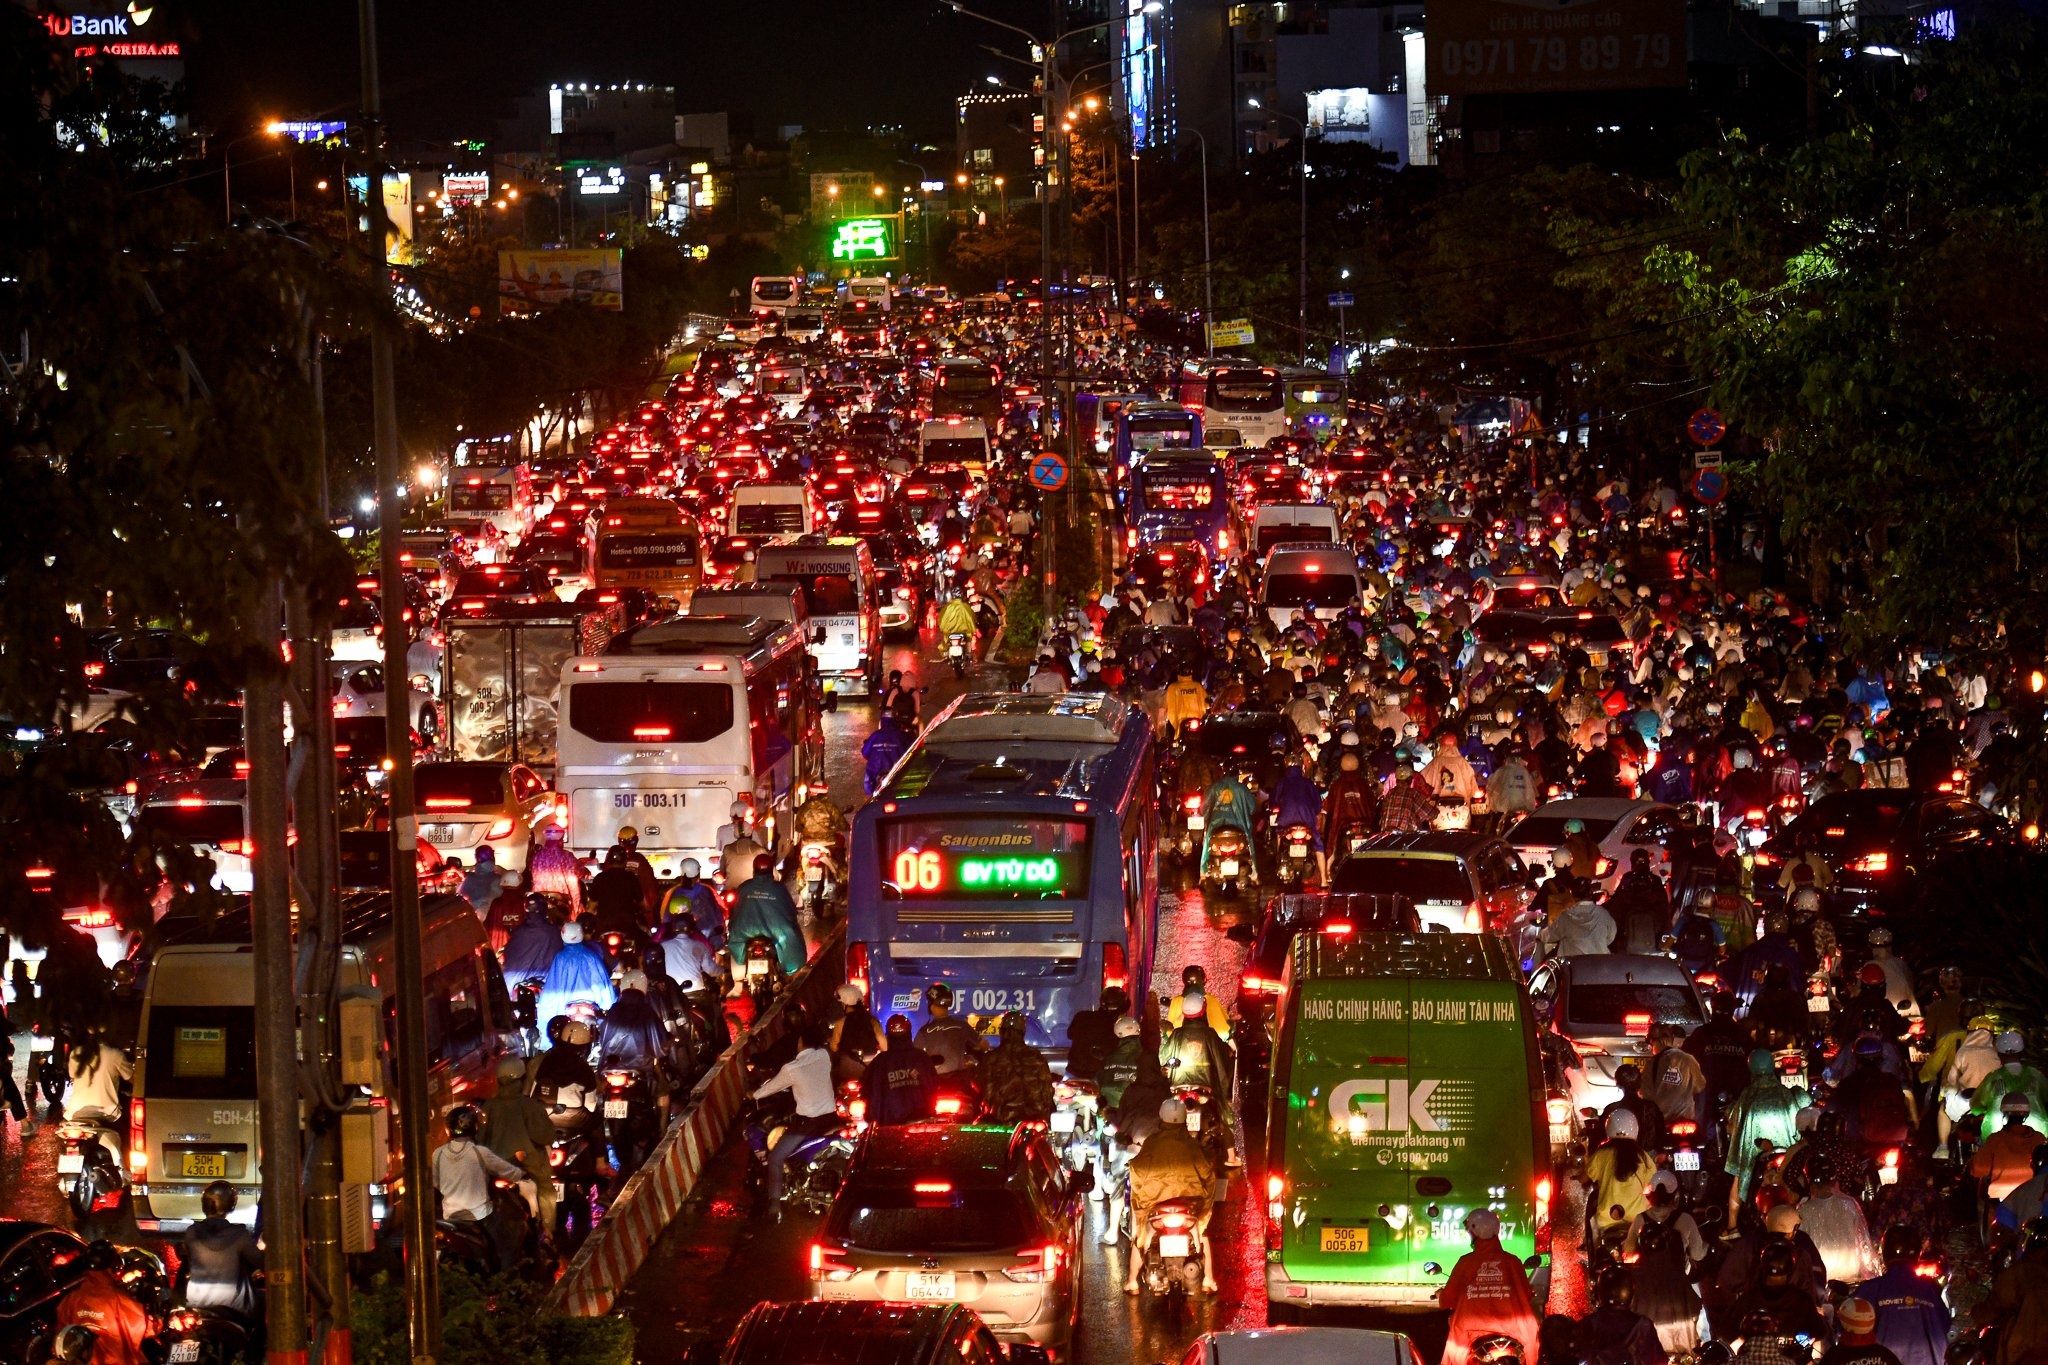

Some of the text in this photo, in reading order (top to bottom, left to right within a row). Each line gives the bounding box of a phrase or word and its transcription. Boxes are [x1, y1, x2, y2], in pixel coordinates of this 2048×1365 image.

[102, 43, 179, 56] AGRIBANK
[1441, 32, 1671, 76] 0971 79 89 79
[1195, 485, 1211, 506] 43
[610, 545, 686, 557] Hotline 089.990.9986
[808, 563, 851, 573] WOOSUNG
[614, 793, 686, 808] 50F-003.11
[940, 835, 1032, 849] SaigonBus
[895, 852, 942, 890] 06
[963, 862, 993, 881] BV
[972, 989, 1036, 1010] 002.31
[1304, 998, 1333, 1022] HÀNG
[1337, 997, 1369, 1020] CHÍNH
[1372, 997, 1402, 1020] HÃNG
[1412, 996, 1433, 1021] BẢO
[1436, 998, 1466, 1021] HÀNH
[1469, 999, 1490, 1022] TẬN
[1493, 999, 1515, 1022] NHÀ
[1328, 1079, 1441, 1131] GK
[1351, 1134, 1466, 1150] dienmaygiakhang.vn
[194, 1156, 213, 1165] 50H
[1396, 1152, 1421, 1163] 1900
[1423, 1152, 1449, 1163] 7049
[187, 1165, 220, 1175] 430.61
[1333, 1229, 1355, 1240] 50G
[1325, 1240, 1363, 1252] 005.87
[920, 1275, 941, 1286] 51K
[911, 1287, 950, 1298] 064.47
[171, 1353, 198, 1362] 521.08
